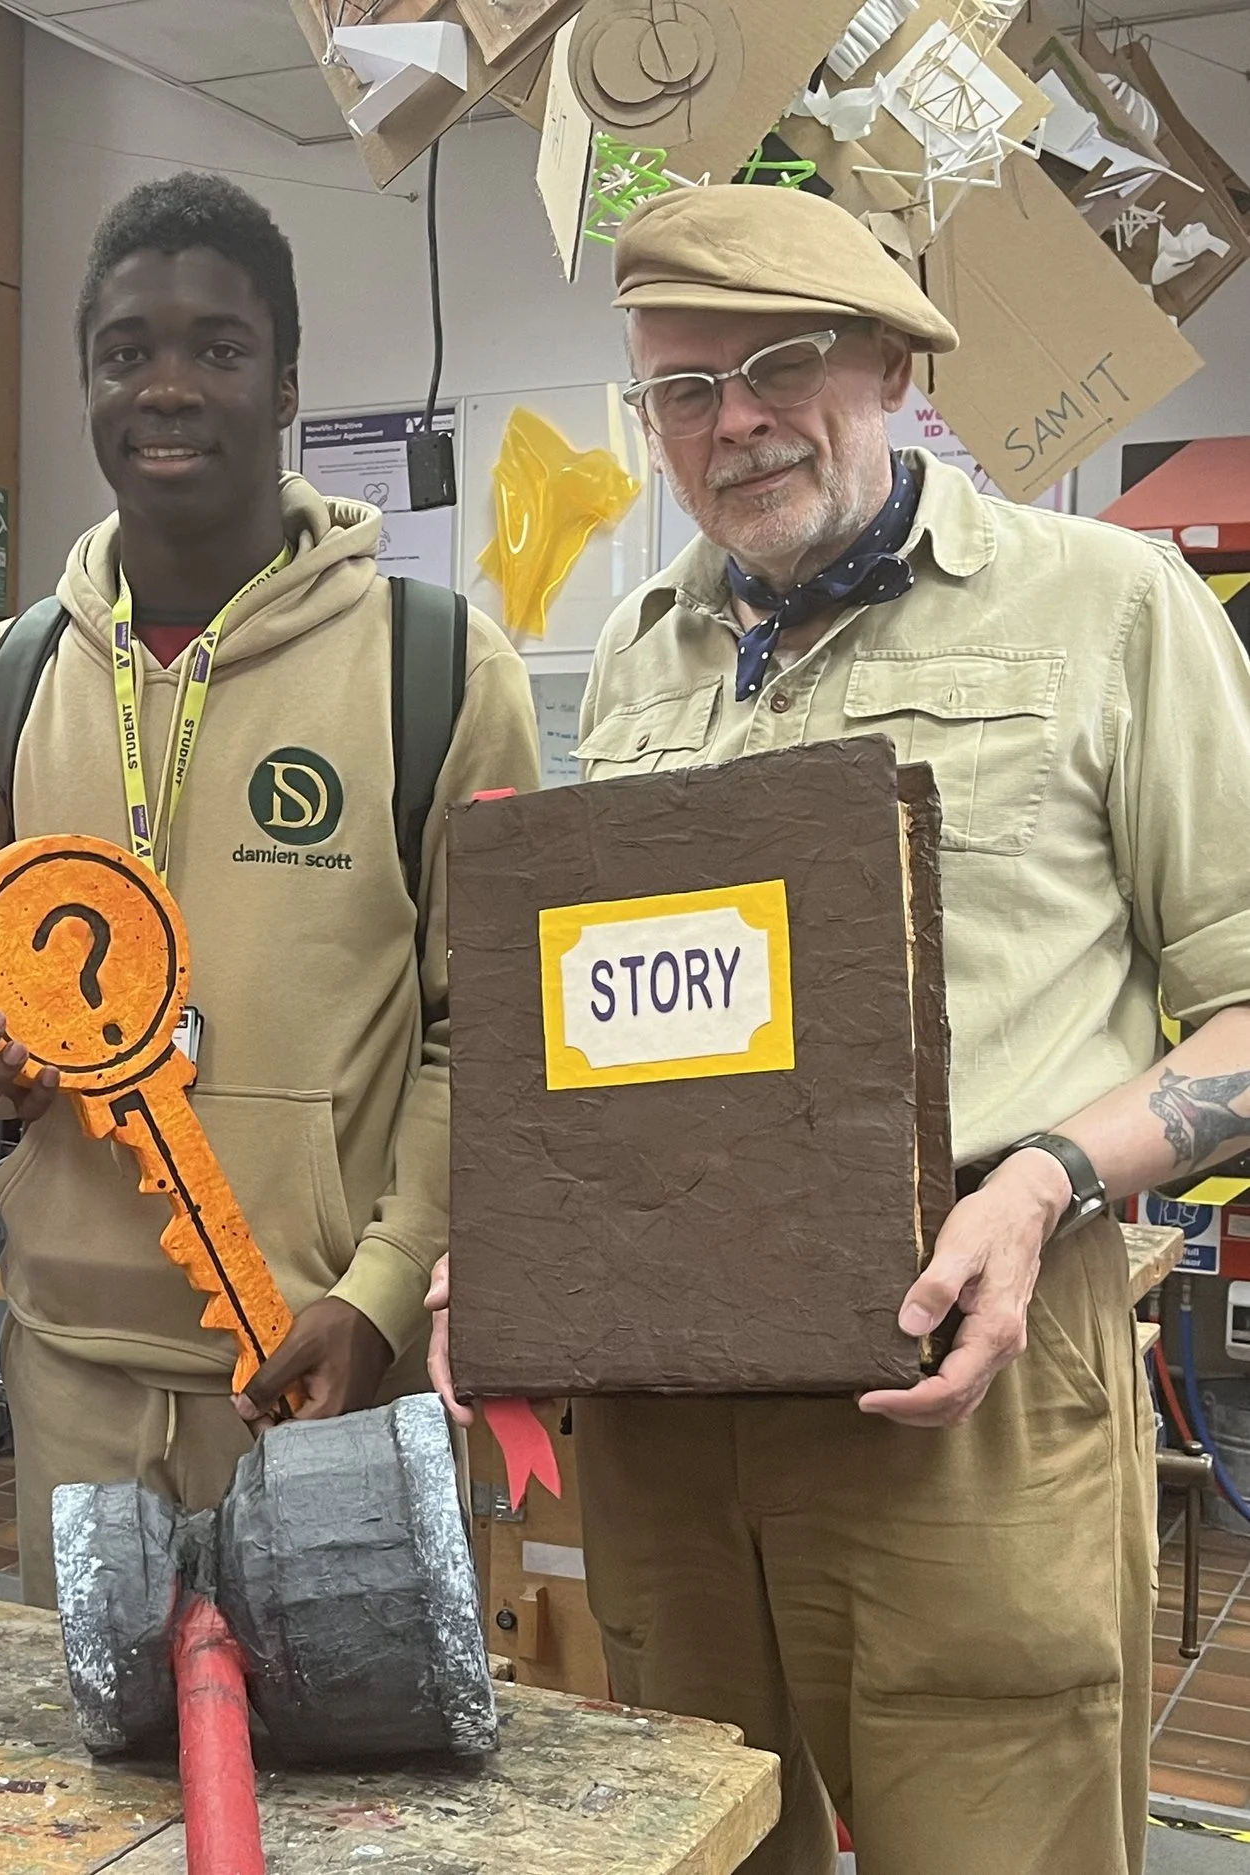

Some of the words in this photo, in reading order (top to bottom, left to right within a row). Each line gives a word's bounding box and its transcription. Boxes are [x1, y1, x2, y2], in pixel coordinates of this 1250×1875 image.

[924, 425, 943, 437] ID
[122, 704, 138, 769] STUDENT
[175, 719, 195, 787] STUDENT
[232, 843, 299, 865] damien
[305, 853, 352, 870] scott
[591, 946, 741, 1022] STORY
